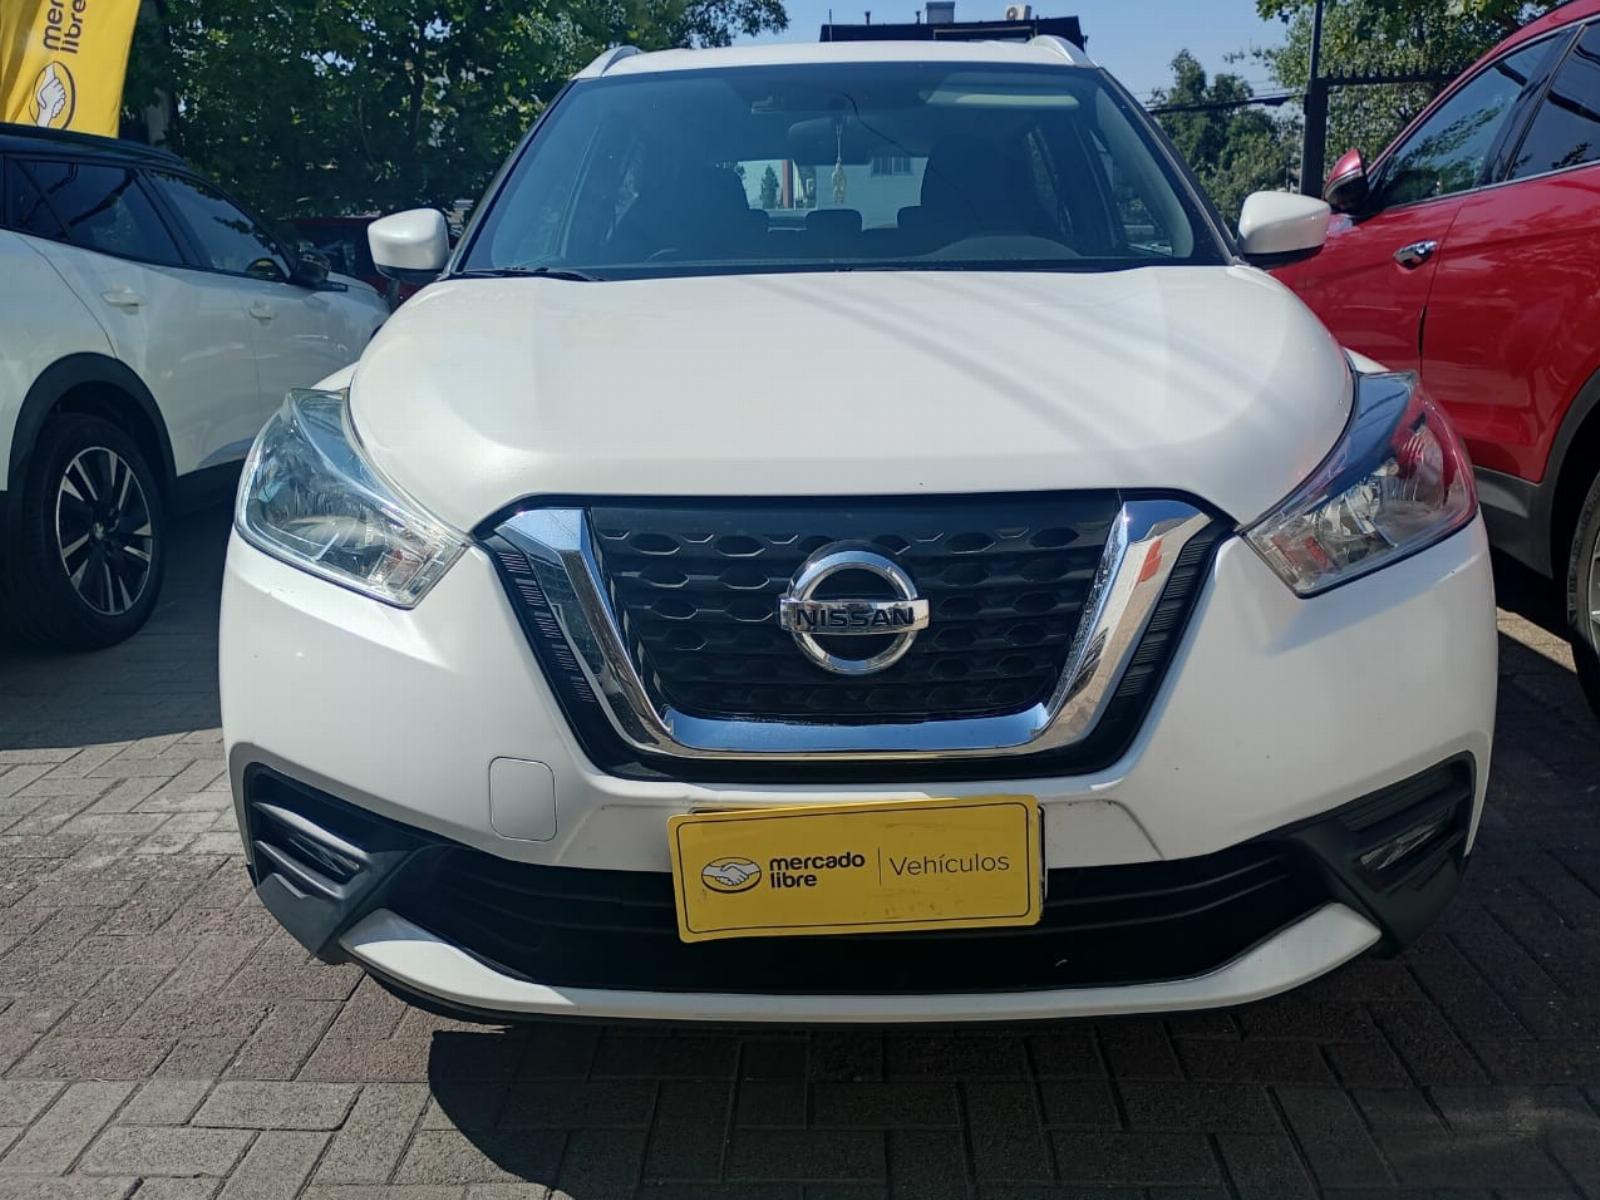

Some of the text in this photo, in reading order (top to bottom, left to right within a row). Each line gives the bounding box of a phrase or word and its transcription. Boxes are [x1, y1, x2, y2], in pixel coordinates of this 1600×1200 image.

[60, 0, 86, 54] libre
[796, 606, 916, 627] NISSAN
[769, 851, 865, 871] mercado
[889, 852, 1010, 876] Vehículos
[770, 872, 818, 888] libre
